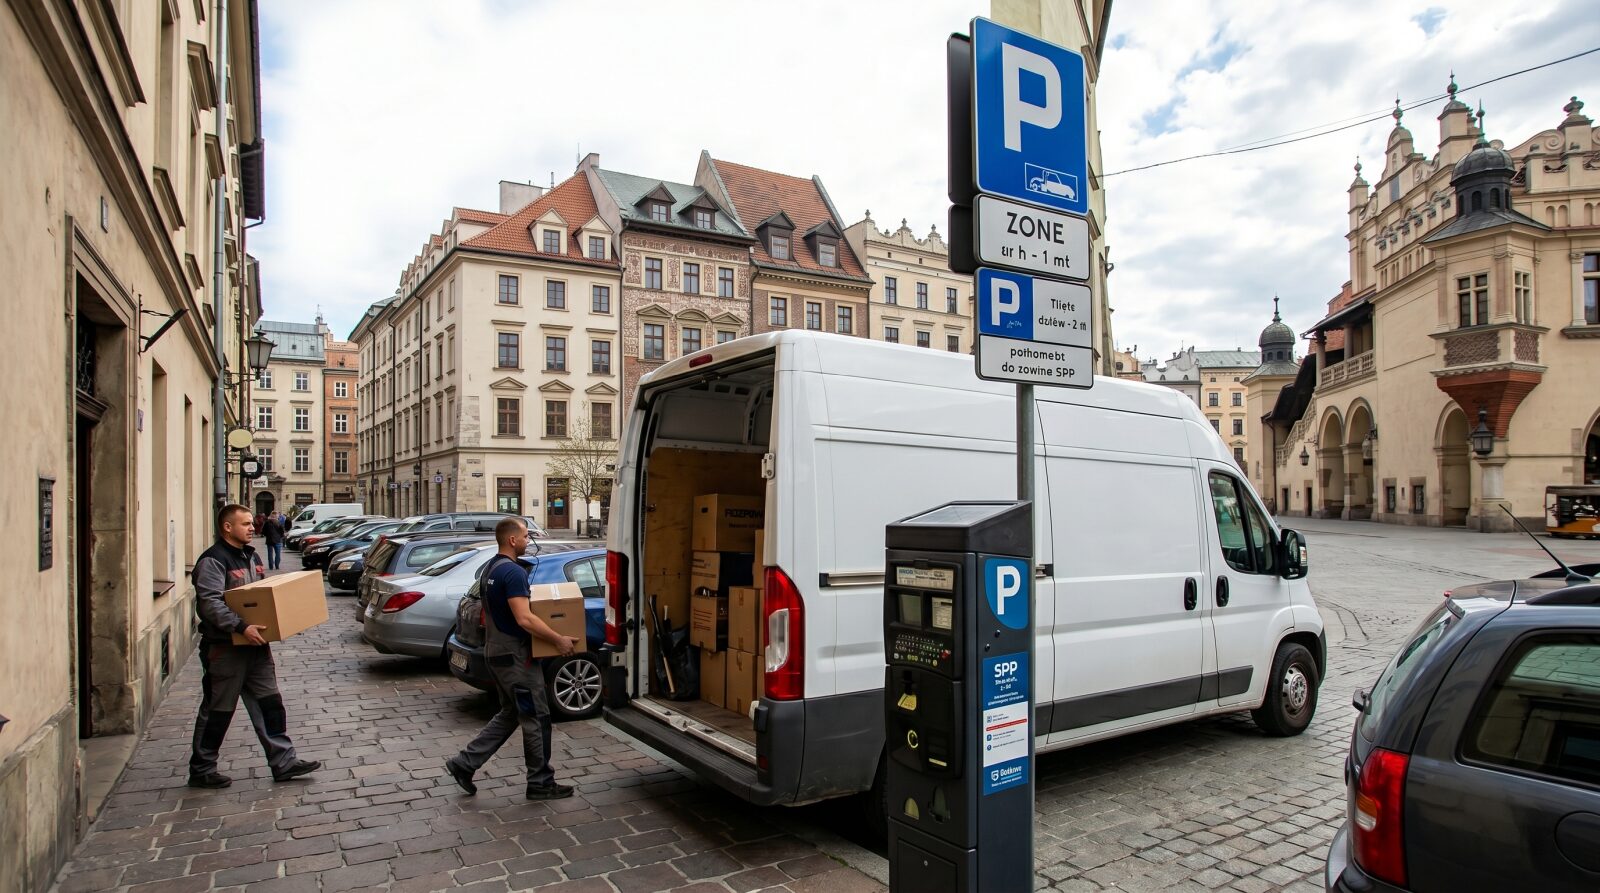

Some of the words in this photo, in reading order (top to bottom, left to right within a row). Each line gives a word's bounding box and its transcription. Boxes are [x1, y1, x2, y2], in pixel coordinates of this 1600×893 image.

[1002, 42, 1062, 152] P
[1007, 212, 1065, 244] ZONE
[990, 277, 1020, 326] P
[1001, 362, 1015, 373] do
[1018, 365, 1053, 376] zowine
[1056, 367, 1075, 378] SPP
[996, 565, 1021, 615] P
[994, 661, 1018, 678] SPP
